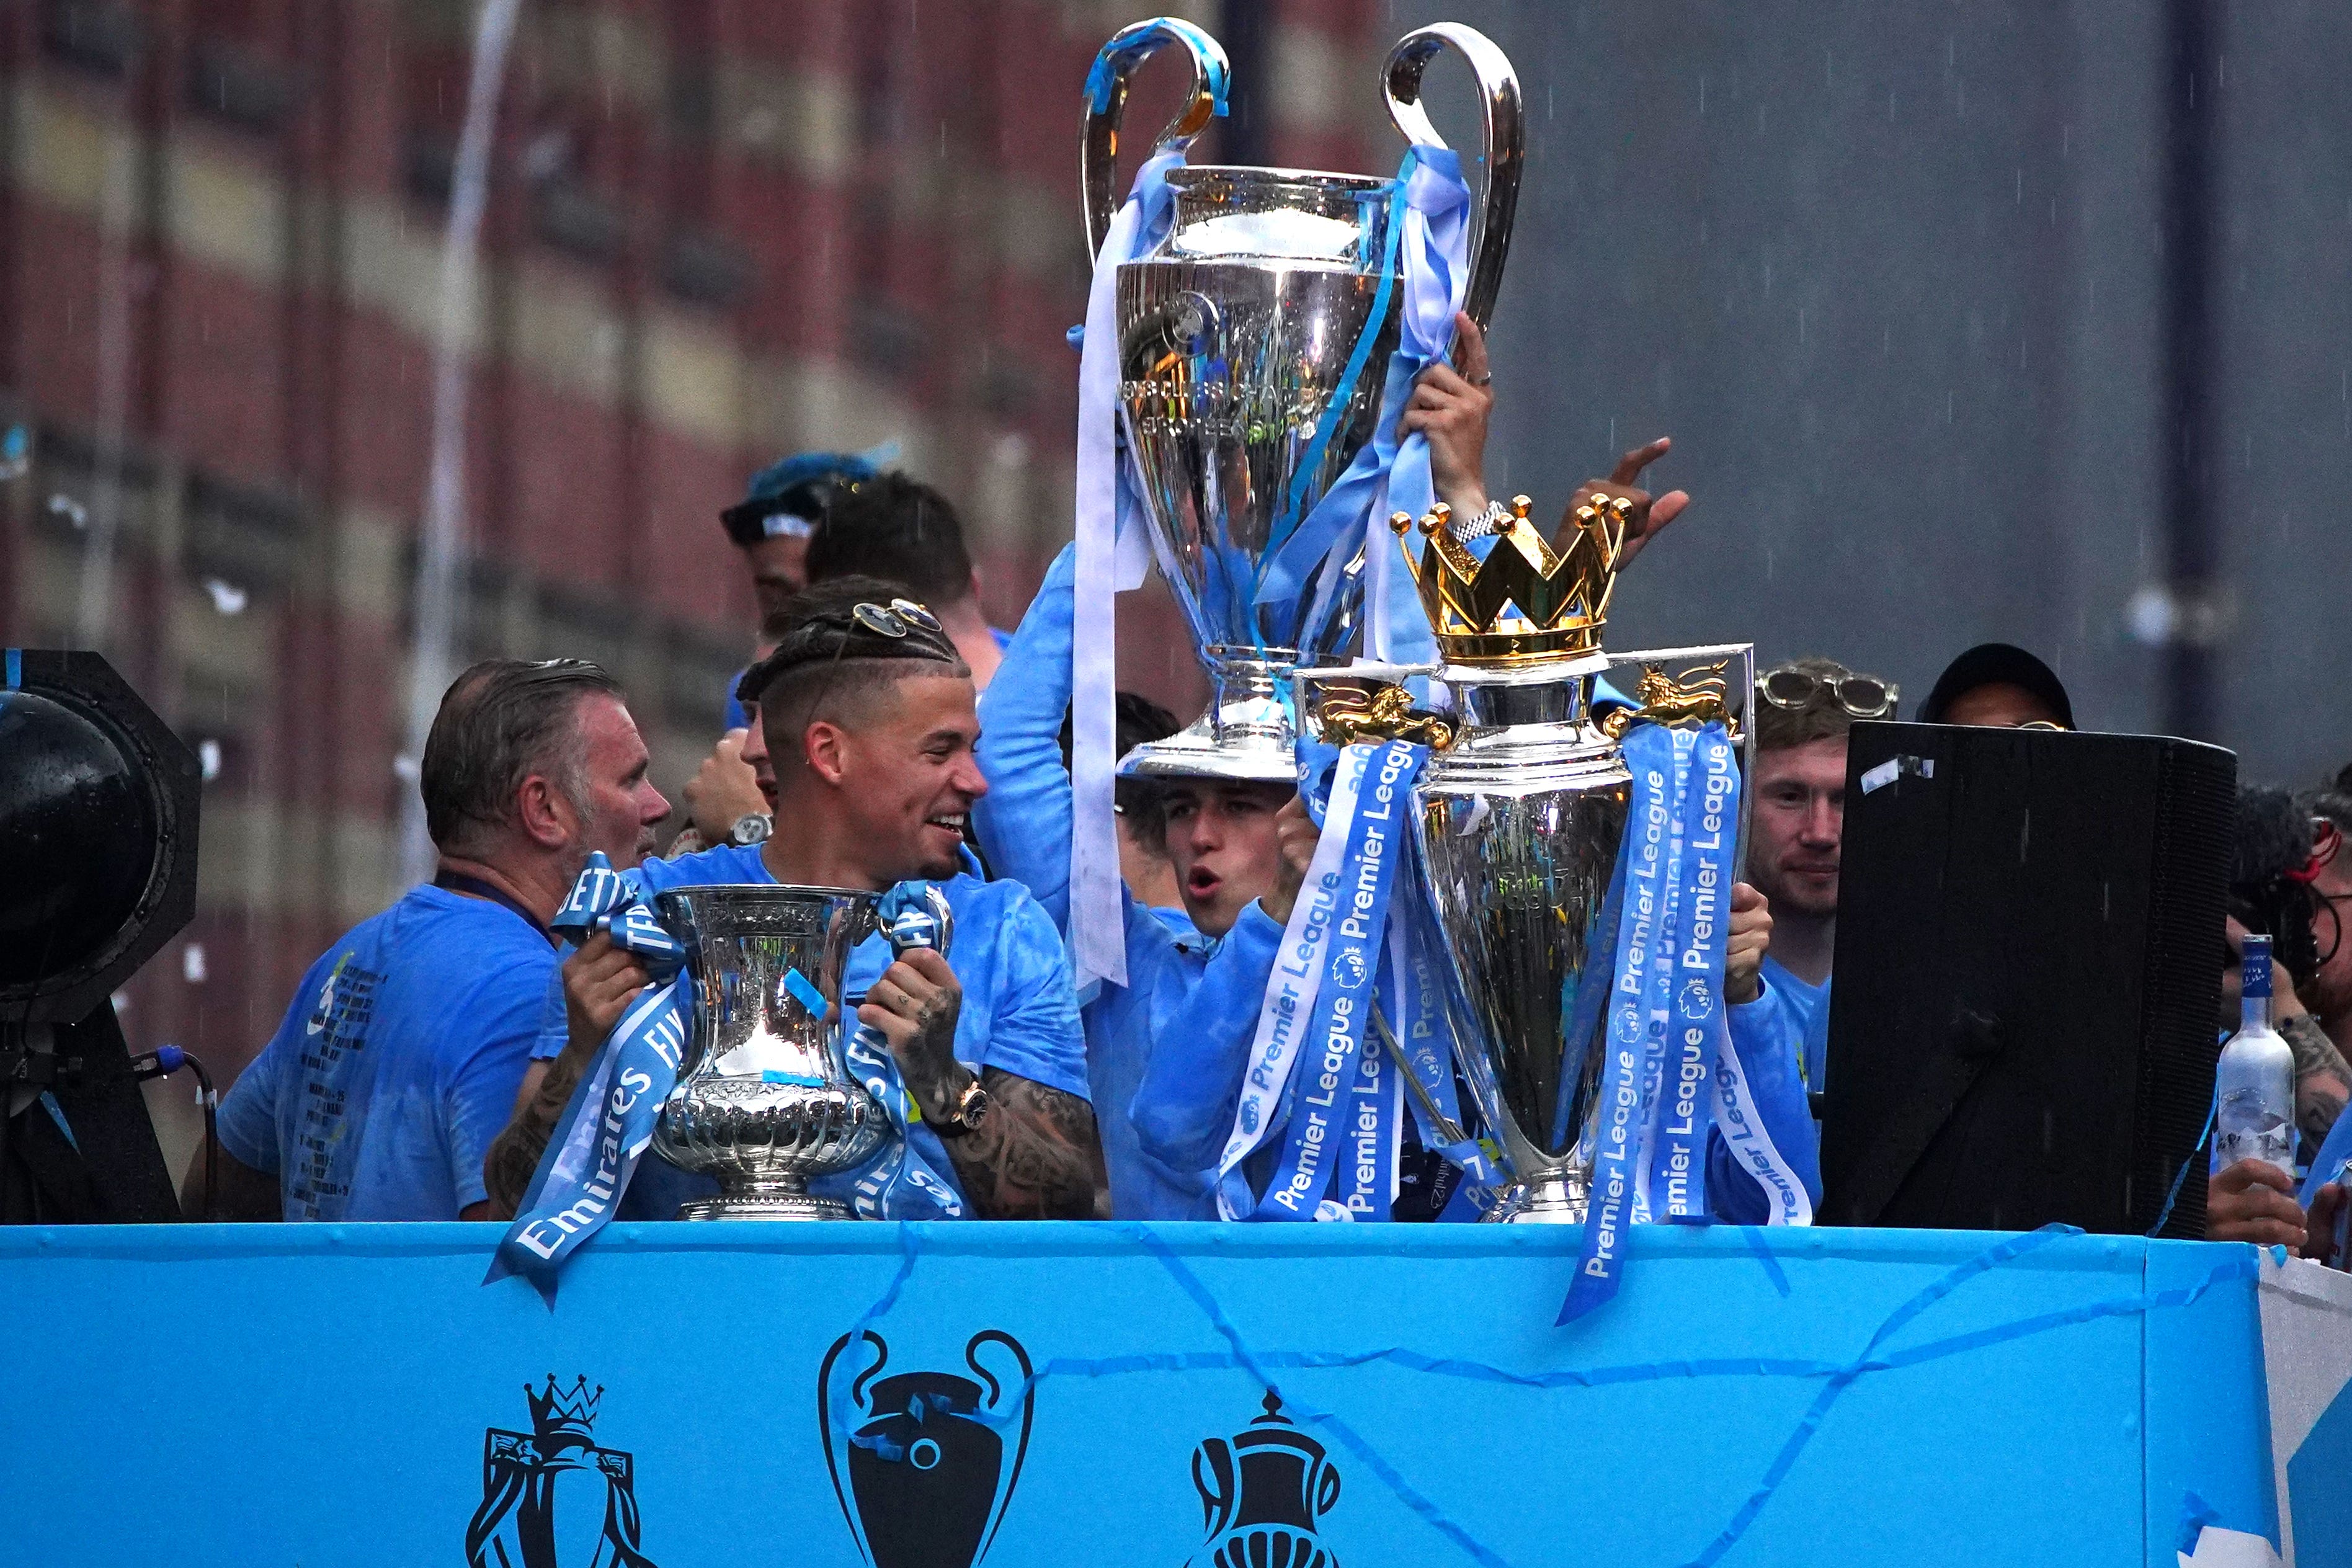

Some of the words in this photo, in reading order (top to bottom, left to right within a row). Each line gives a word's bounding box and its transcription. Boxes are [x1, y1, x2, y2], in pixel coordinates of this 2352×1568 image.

[1340, 826, 1386, 940] Premier
[1363, 739, 1417, 820] Leagu
[1635, 770, 1667, 878] League
[1692, 745, 1733, 849] League
[1620, 885, 1654, 995] Premier
[1683, 857, 1718, 969] Premier
[1251, 982, 1298, 1090] Premier
[1281, 871, 1340, 979] League
[1275, 1113, 1327, 1212] Premier
[1306, 996, 1354, 1107] League
[1604, 1051, 1637, 1161] League
[1666, 1028, 1707, 1134] League
[515, 1067, 652, 1260] Emirates
[1347, 1102, 1378, 1213] Premier
[1662, 1142, 1690, 1216] emier
[1745, 1147, 1798, 1225] remier
[1585, 1167, 1625, 1278] Premier
